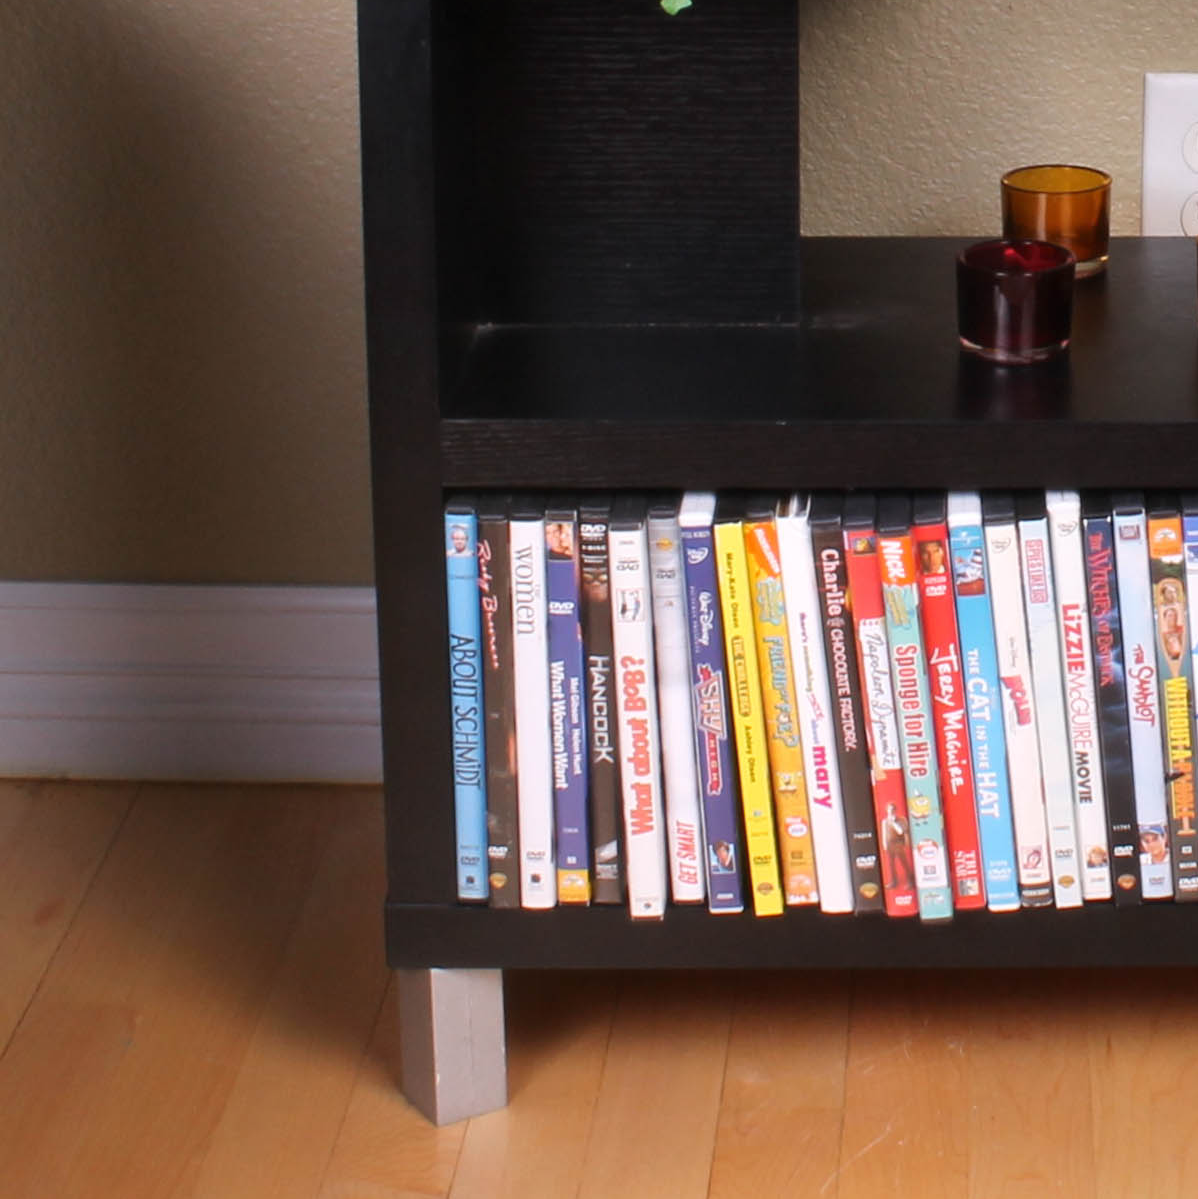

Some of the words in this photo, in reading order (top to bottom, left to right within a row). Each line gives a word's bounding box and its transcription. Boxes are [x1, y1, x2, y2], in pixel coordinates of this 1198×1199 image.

[822, 549, 845, 616] Charlie
[880, 540, 906, 578] NICK
[514, 546, 535, 635] women
[549, 602, 574, 614] DVD
[450, 633, 478, 701] ABOUT
[550, 660, 565, 699] What
[831, 629, 849, 697] CHOCOLATE
[865, 631, 888, 699] Napoleon
[895, 644, 920, 711] Sponge
[967, 649, 980, 673] THE
[588, 656, 614, 764] HANCOCK
[967, 677, 990, 721] CAT
[1067, 672, 1093, 748] McGUIRE
[1129, 665, 1156, 727] SANDLOT
[1164, 677, 1191, 746] WITHOUT
[552, 701, 567, 753] Women
[625, 717, 650, 777] about
[871, 701, 896, 767] Dynamite
[904, 714, 924, 738] for
[975, 725, 986, 741] IN
[555, 753, 569, 790] Want
[812, 746, 833, 809] mary
[907, 742, 929, 777] Hire
[976, 745, 989, 769] THE
[1075, 751, 1093, 804] MOVIE
[1171, 748, 1192, 761] A
[631, 783, 654, 835] What
[977, 772, 1000, 818] HAT
[676, 820, 697, 860] SMART
[678, 862, 699, 885] GET
